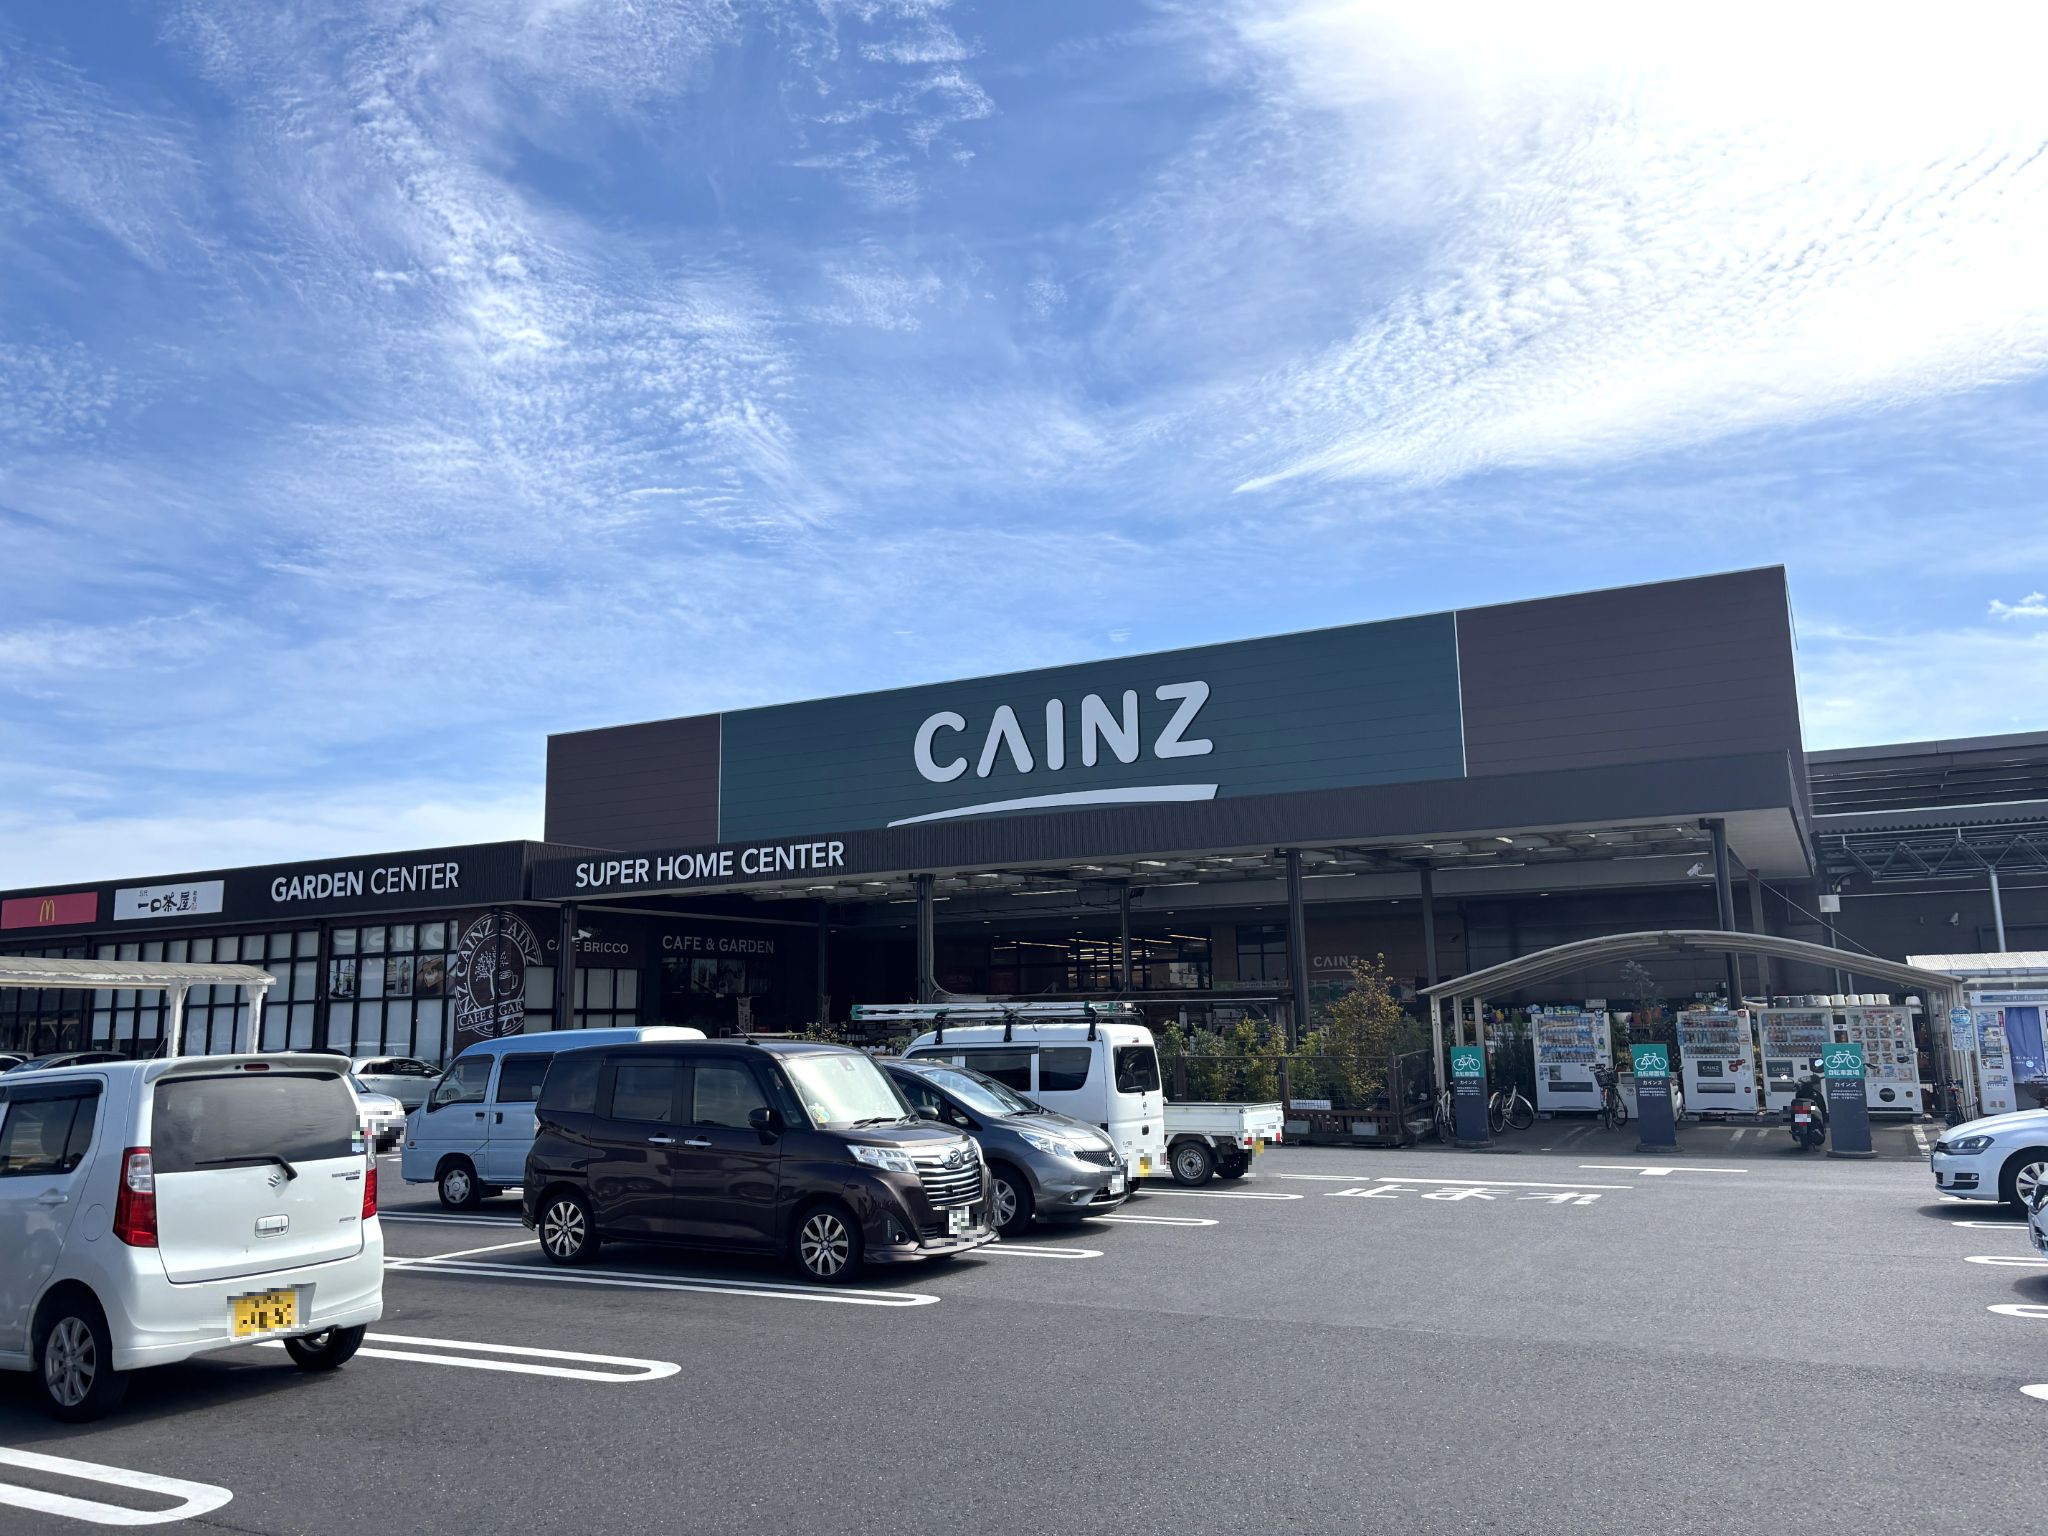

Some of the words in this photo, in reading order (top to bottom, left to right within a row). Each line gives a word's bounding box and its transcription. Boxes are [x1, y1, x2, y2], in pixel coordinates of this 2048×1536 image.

[914, 680, 1214, 783] CAINZ
[575, 858, 650, 888] SUPER
[656, 850, 734, 881] HOME
[741, 841, 845, 874] CENTER
[271, 870, 364, 902] GARDEN
[370, 862, 459, 895] CENTER
[137, 891, 192, 913] 一口茶屋
[456, 918, 494, 977] CAINZ
[583, 941, 629, 954] BRICCO
[662, 935, 702, 950] CAFE
[706, 938, 715, 950] &
[719, 938, 774, 954] GARDEN
[459, 1010, 486, 1027] CAFE
[488, 1008, 494, 1019] &
[1323, 1184, 1603, 1205] 止まれ
